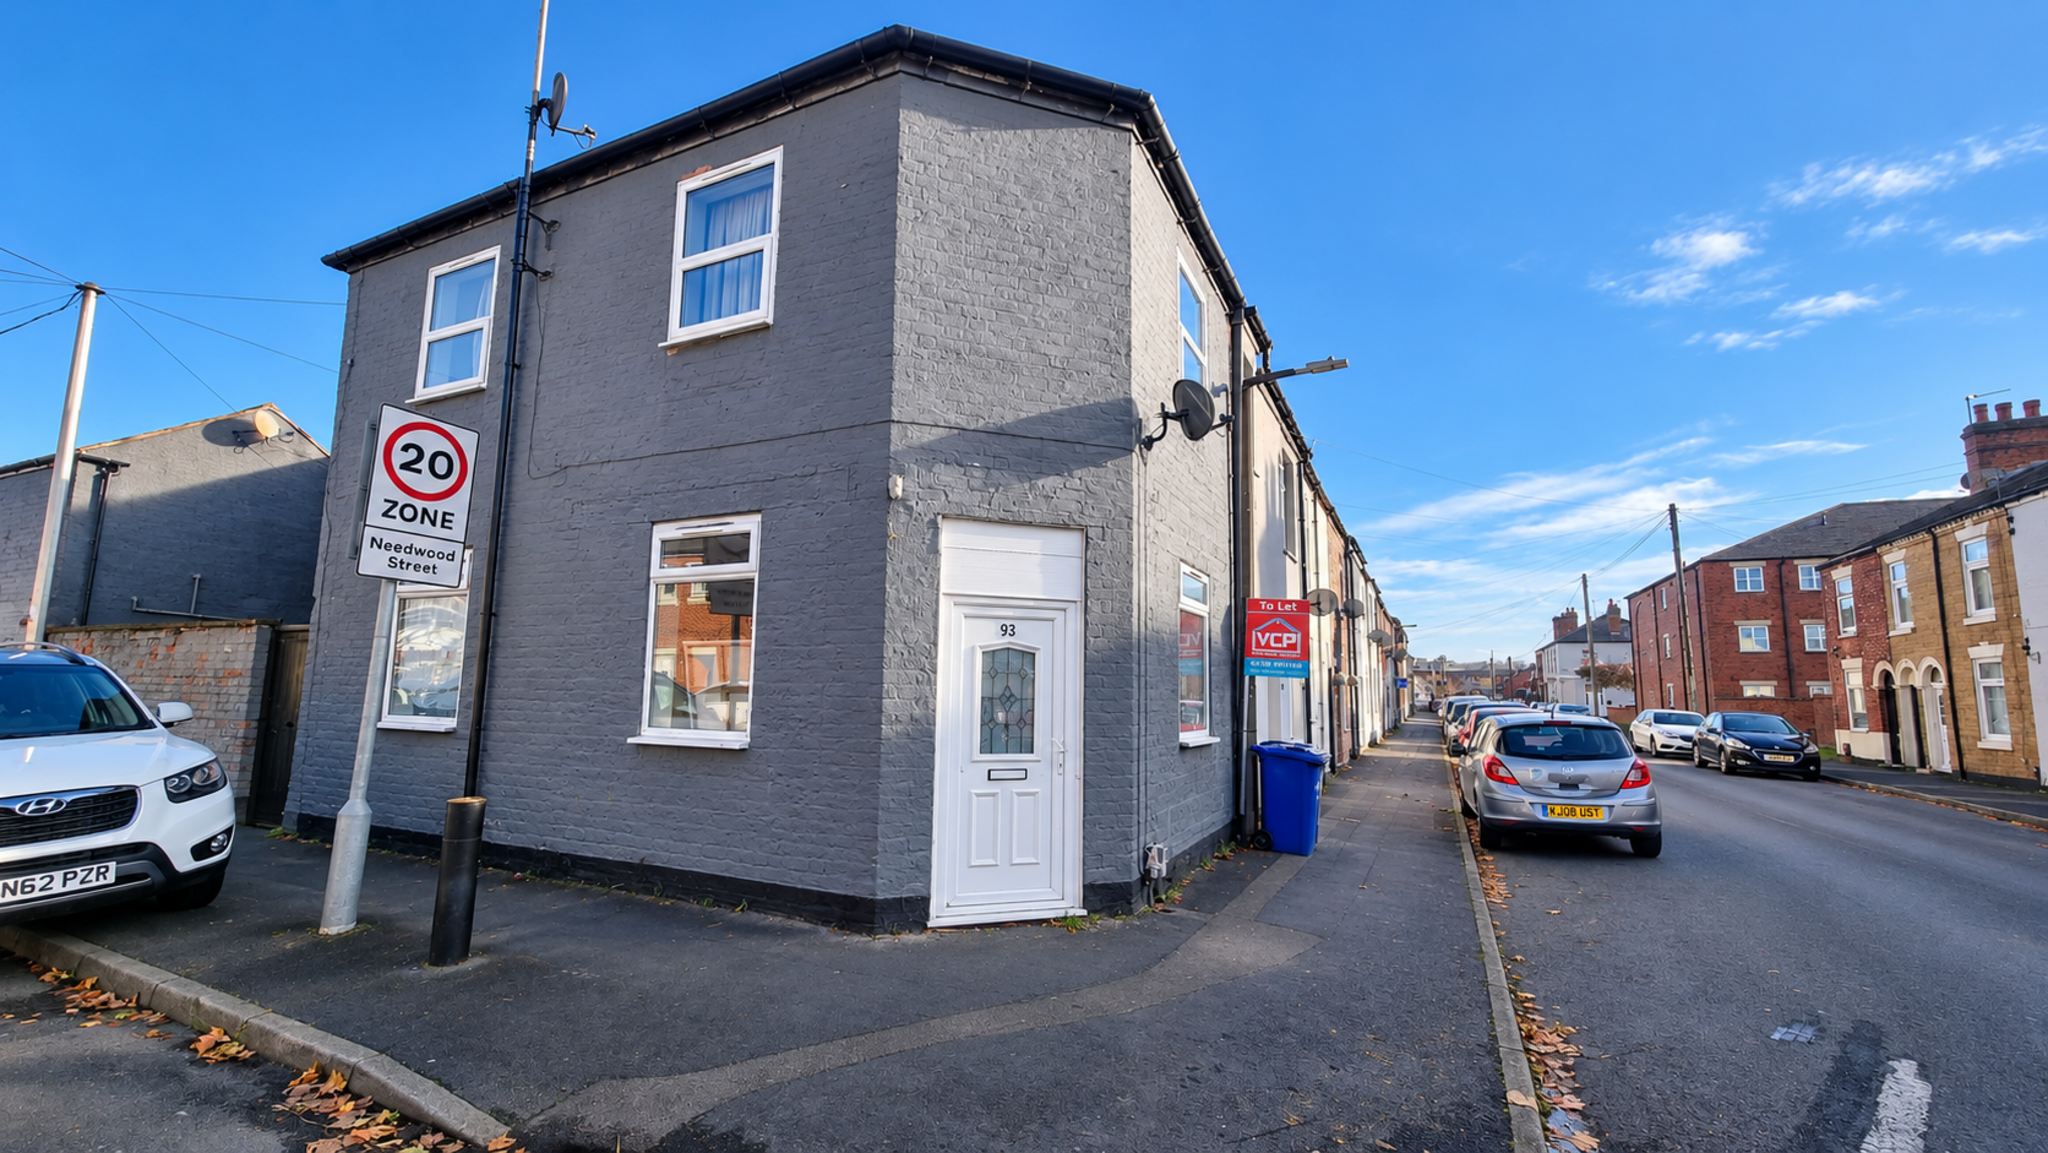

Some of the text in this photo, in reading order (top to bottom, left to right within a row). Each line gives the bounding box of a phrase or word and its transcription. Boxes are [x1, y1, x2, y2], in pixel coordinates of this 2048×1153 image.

[398, 442, 454, 480] 20
[381, 498, 455, 530] ZONE
[369, 536, 456, 562] Needwood
[387, 556, 438, 575] Street
[1259, 601, 1297, 611] To Let
[1000, 623, 1016, 637] 93
[1256, 631, 1297, 648] VCP
[1580, 807, 1599, 818] UST
[0, 864, 110, 899] N62 PZR
